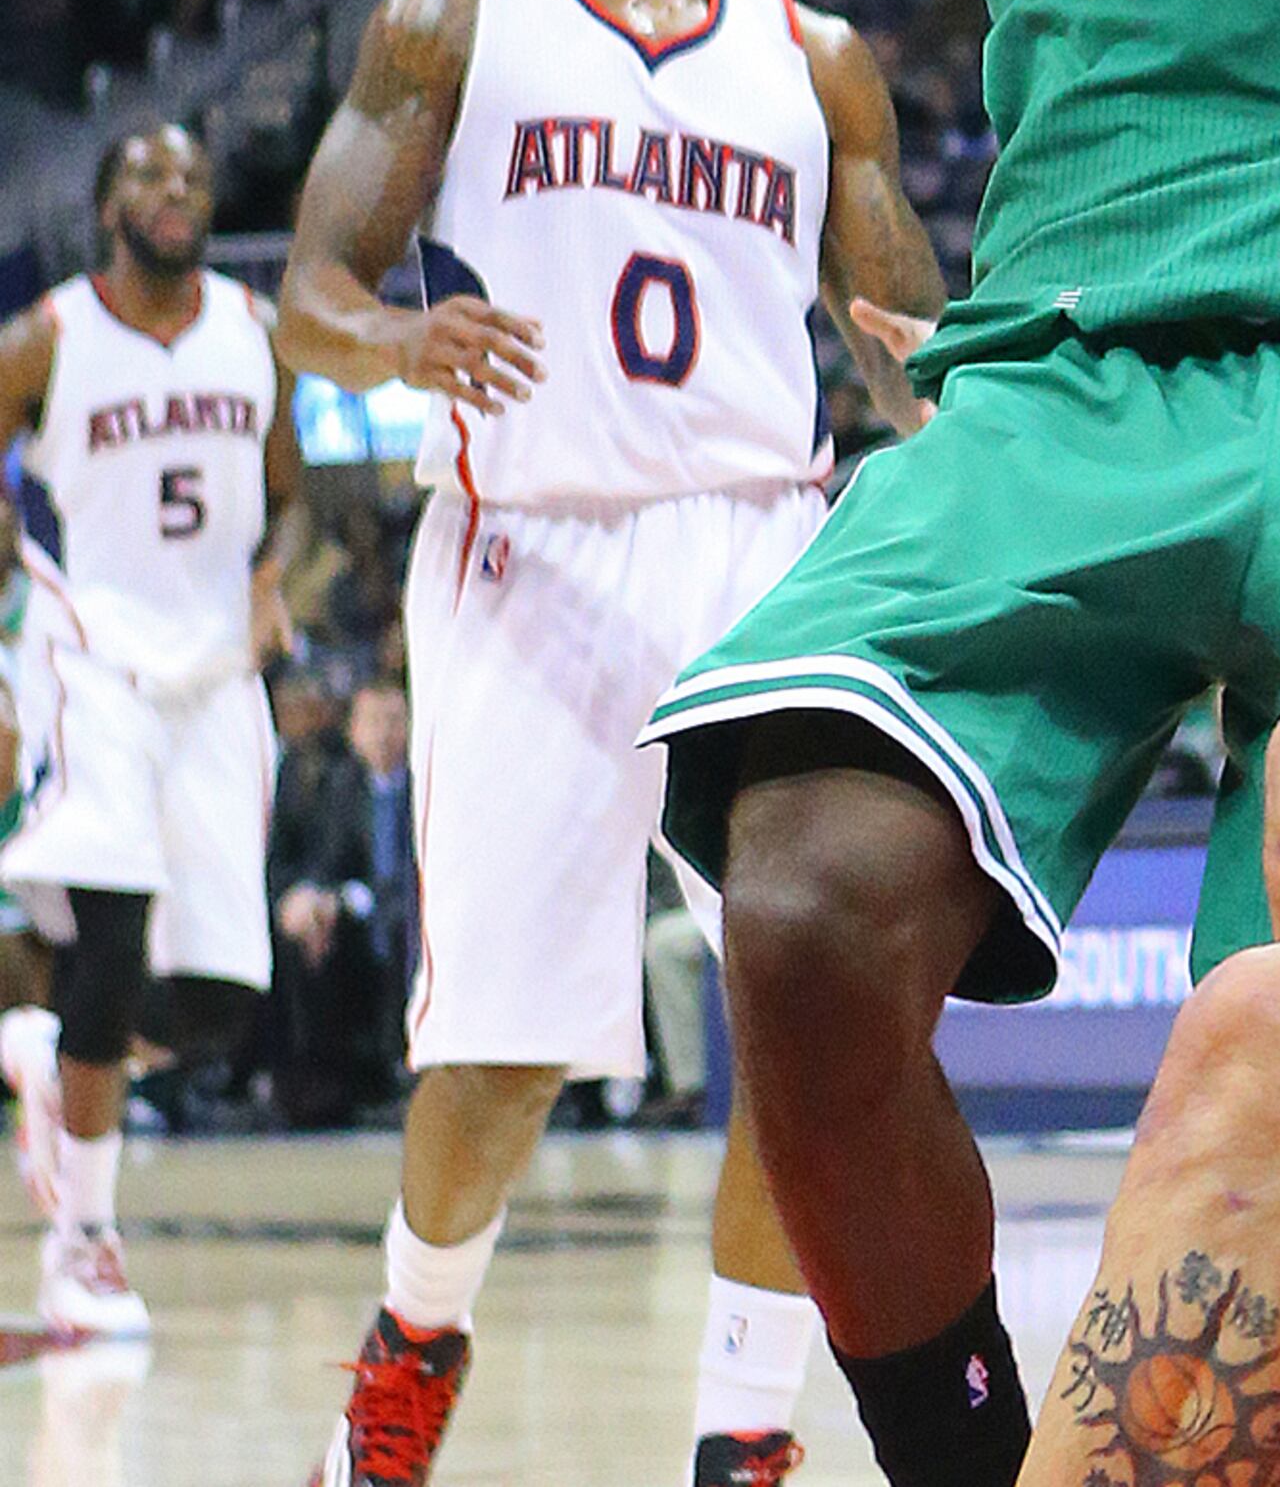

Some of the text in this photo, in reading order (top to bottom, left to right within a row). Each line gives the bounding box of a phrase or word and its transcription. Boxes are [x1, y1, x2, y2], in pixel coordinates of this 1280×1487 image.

[502, 115, 797, 251] ATLANTA
[610, 250, 701, 389] 0
[89, 390, 258, 453] ATLANTA
[160, 468, 206, 539] 5
